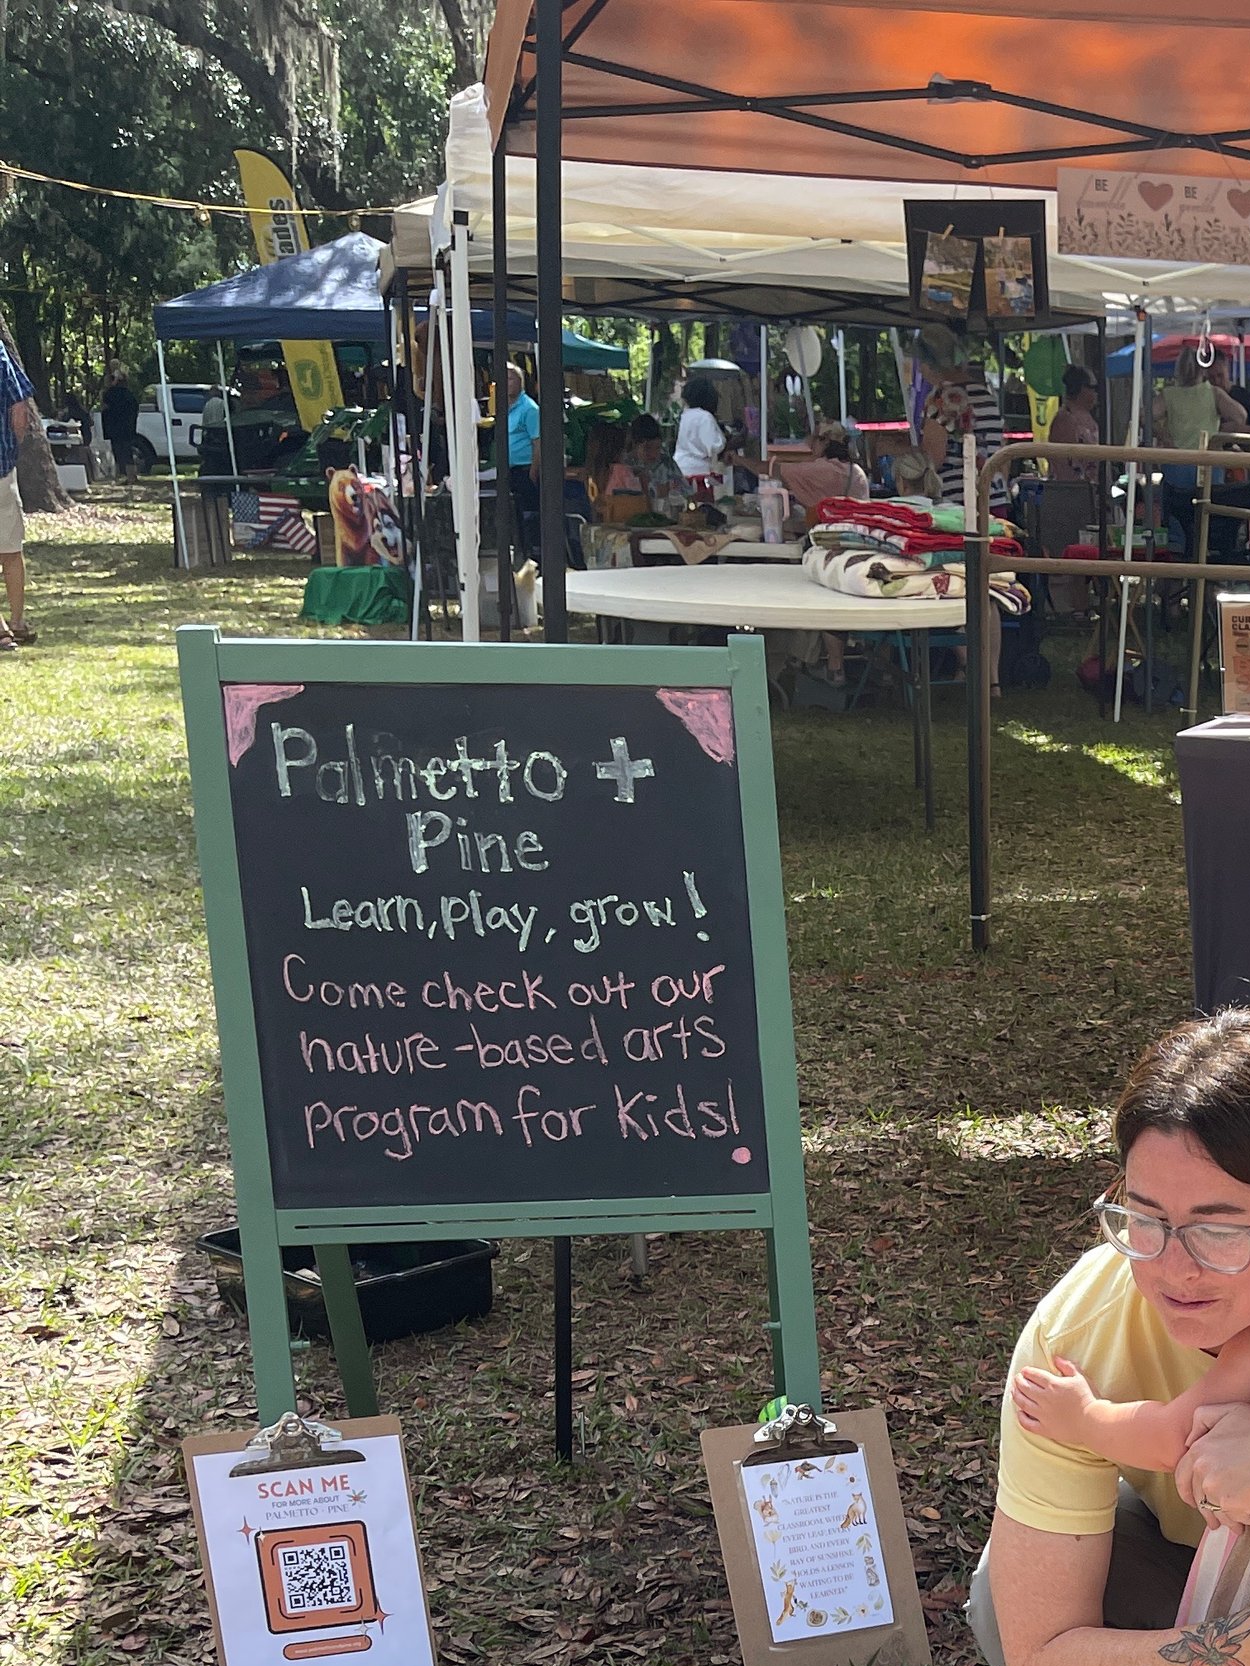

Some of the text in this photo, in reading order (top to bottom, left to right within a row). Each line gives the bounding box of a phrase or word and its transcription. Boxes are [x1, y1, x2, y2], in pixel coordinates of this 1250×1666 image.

[1094, 179, 1109, 192] BE
[1184, 186, 1197, 199] BE
[270, 721, 654, 806] Palmetto +
[407, 809, 551, 874] Pine
[283, 953, 726, 1013] Come check out our
[300, 1014, 726, 1075] nature-based arts
[305, 1098, 503, 1160] program
[512, 1084, 598, 1148] for
[258, 1474, 350, 1499] SCAN ME
[272, 1495, 339, 1508] FOR MORE ABOUT
[823, 1491, 838, 1499] THE
[266, 1508, 318, 1520] PALMETTO
[328, 1504, 349, 1513] PINE
[793, 1504, 831, 1517] GREATEST
[782, 1533, 807, 1543] EVERY
[810, 1542, 826, 1550] AND
[826, 1538, 850, 1547] EVERY
[790, 1558, 804, 1566] RAY
[817, 1550, 854, 1561] SUNSHINE
[825, 1562, 854, 1572] LESSON
[799, 1578, 832, 1589] WAITING
[844, 1573, 854, 1581] BE
